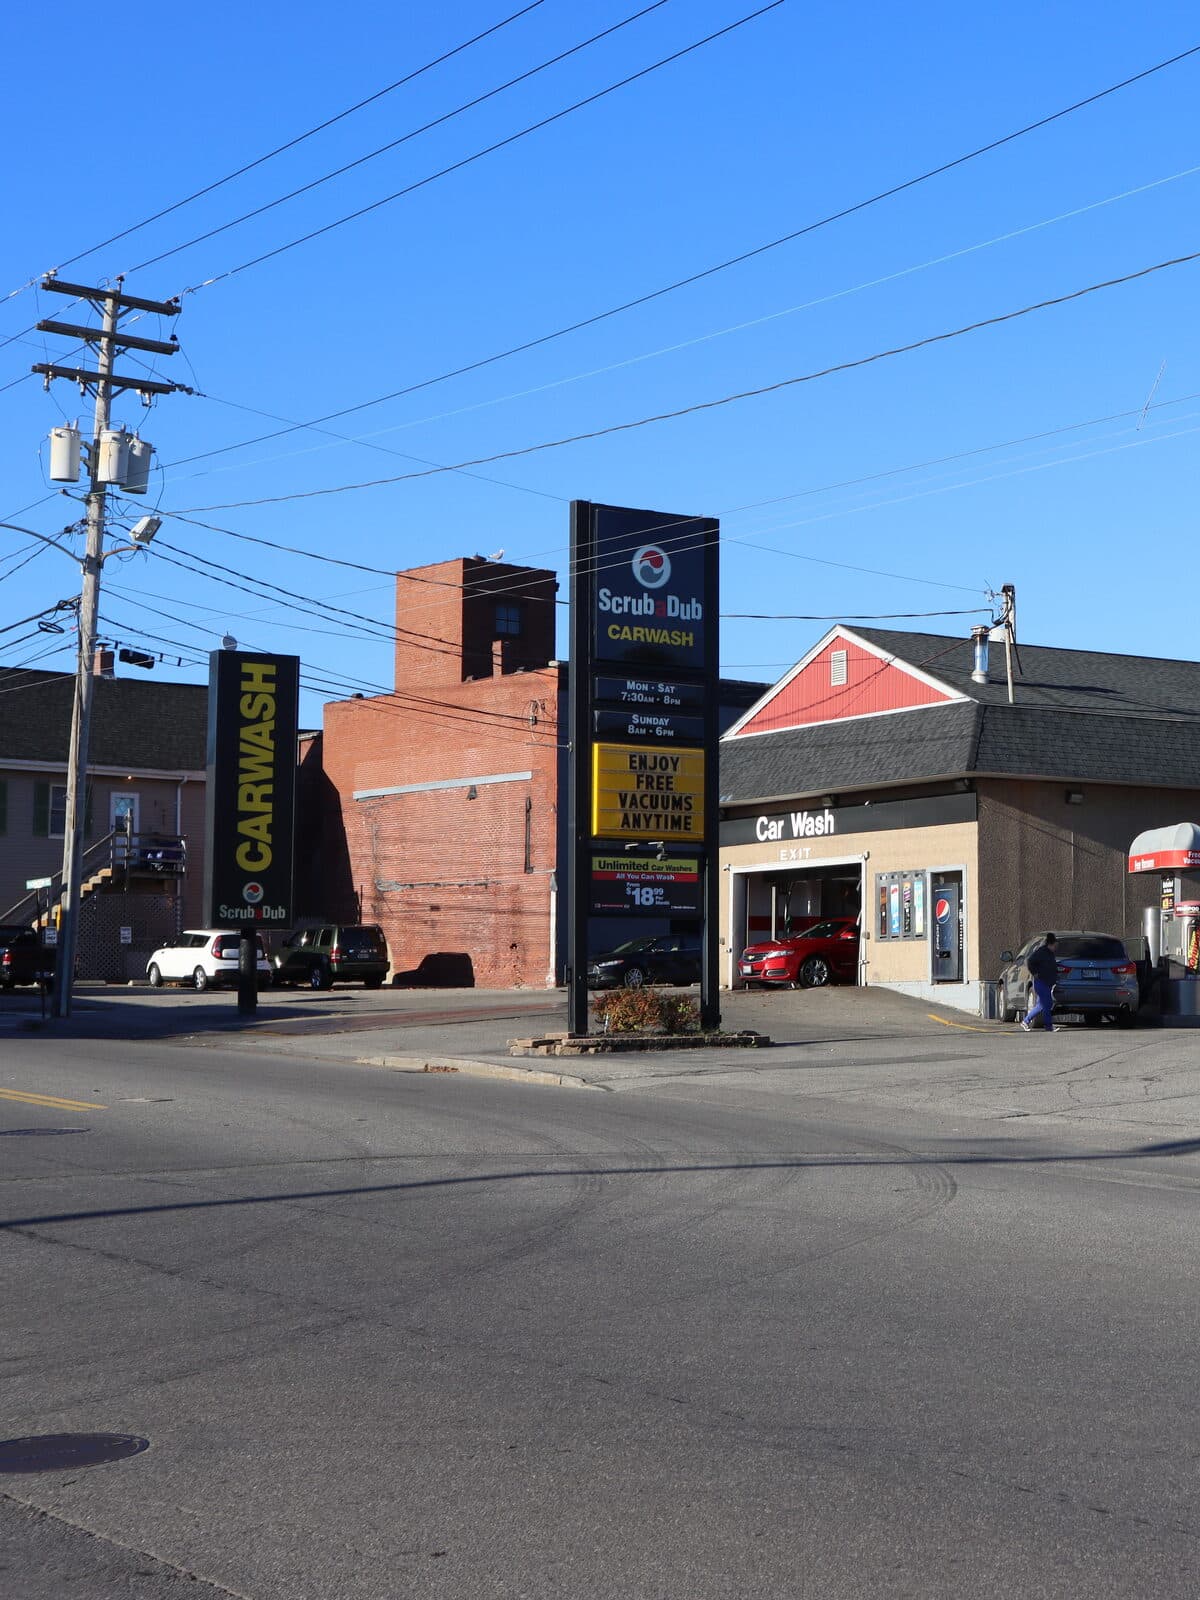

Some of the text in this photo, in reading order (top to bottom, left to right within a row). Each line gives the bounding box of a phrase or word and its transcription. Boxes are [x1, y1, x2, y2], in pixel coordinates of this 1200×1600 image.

[607, 624, 694, 646] CARWASH
[663, 695, 681, 705] 8PM
[631, 714, 670, 726] SUNDAY
[627, 724, 647, 735] 8AM
[655, 727, 674, 737] 6PM
[236, 662, 277, 873] CARWASH
[629, 754, 680, 771] ENJOY
[637, 774, 674, 791] FREE
[618, 793, 693, 811] VACUUMS
[621, 813, 692, 831] ANYTIME
[756, 809, 834, 841] Car Wash
[780, 848, 811, 860] EXIT
[598, 860, 648, 871] Unlimited
